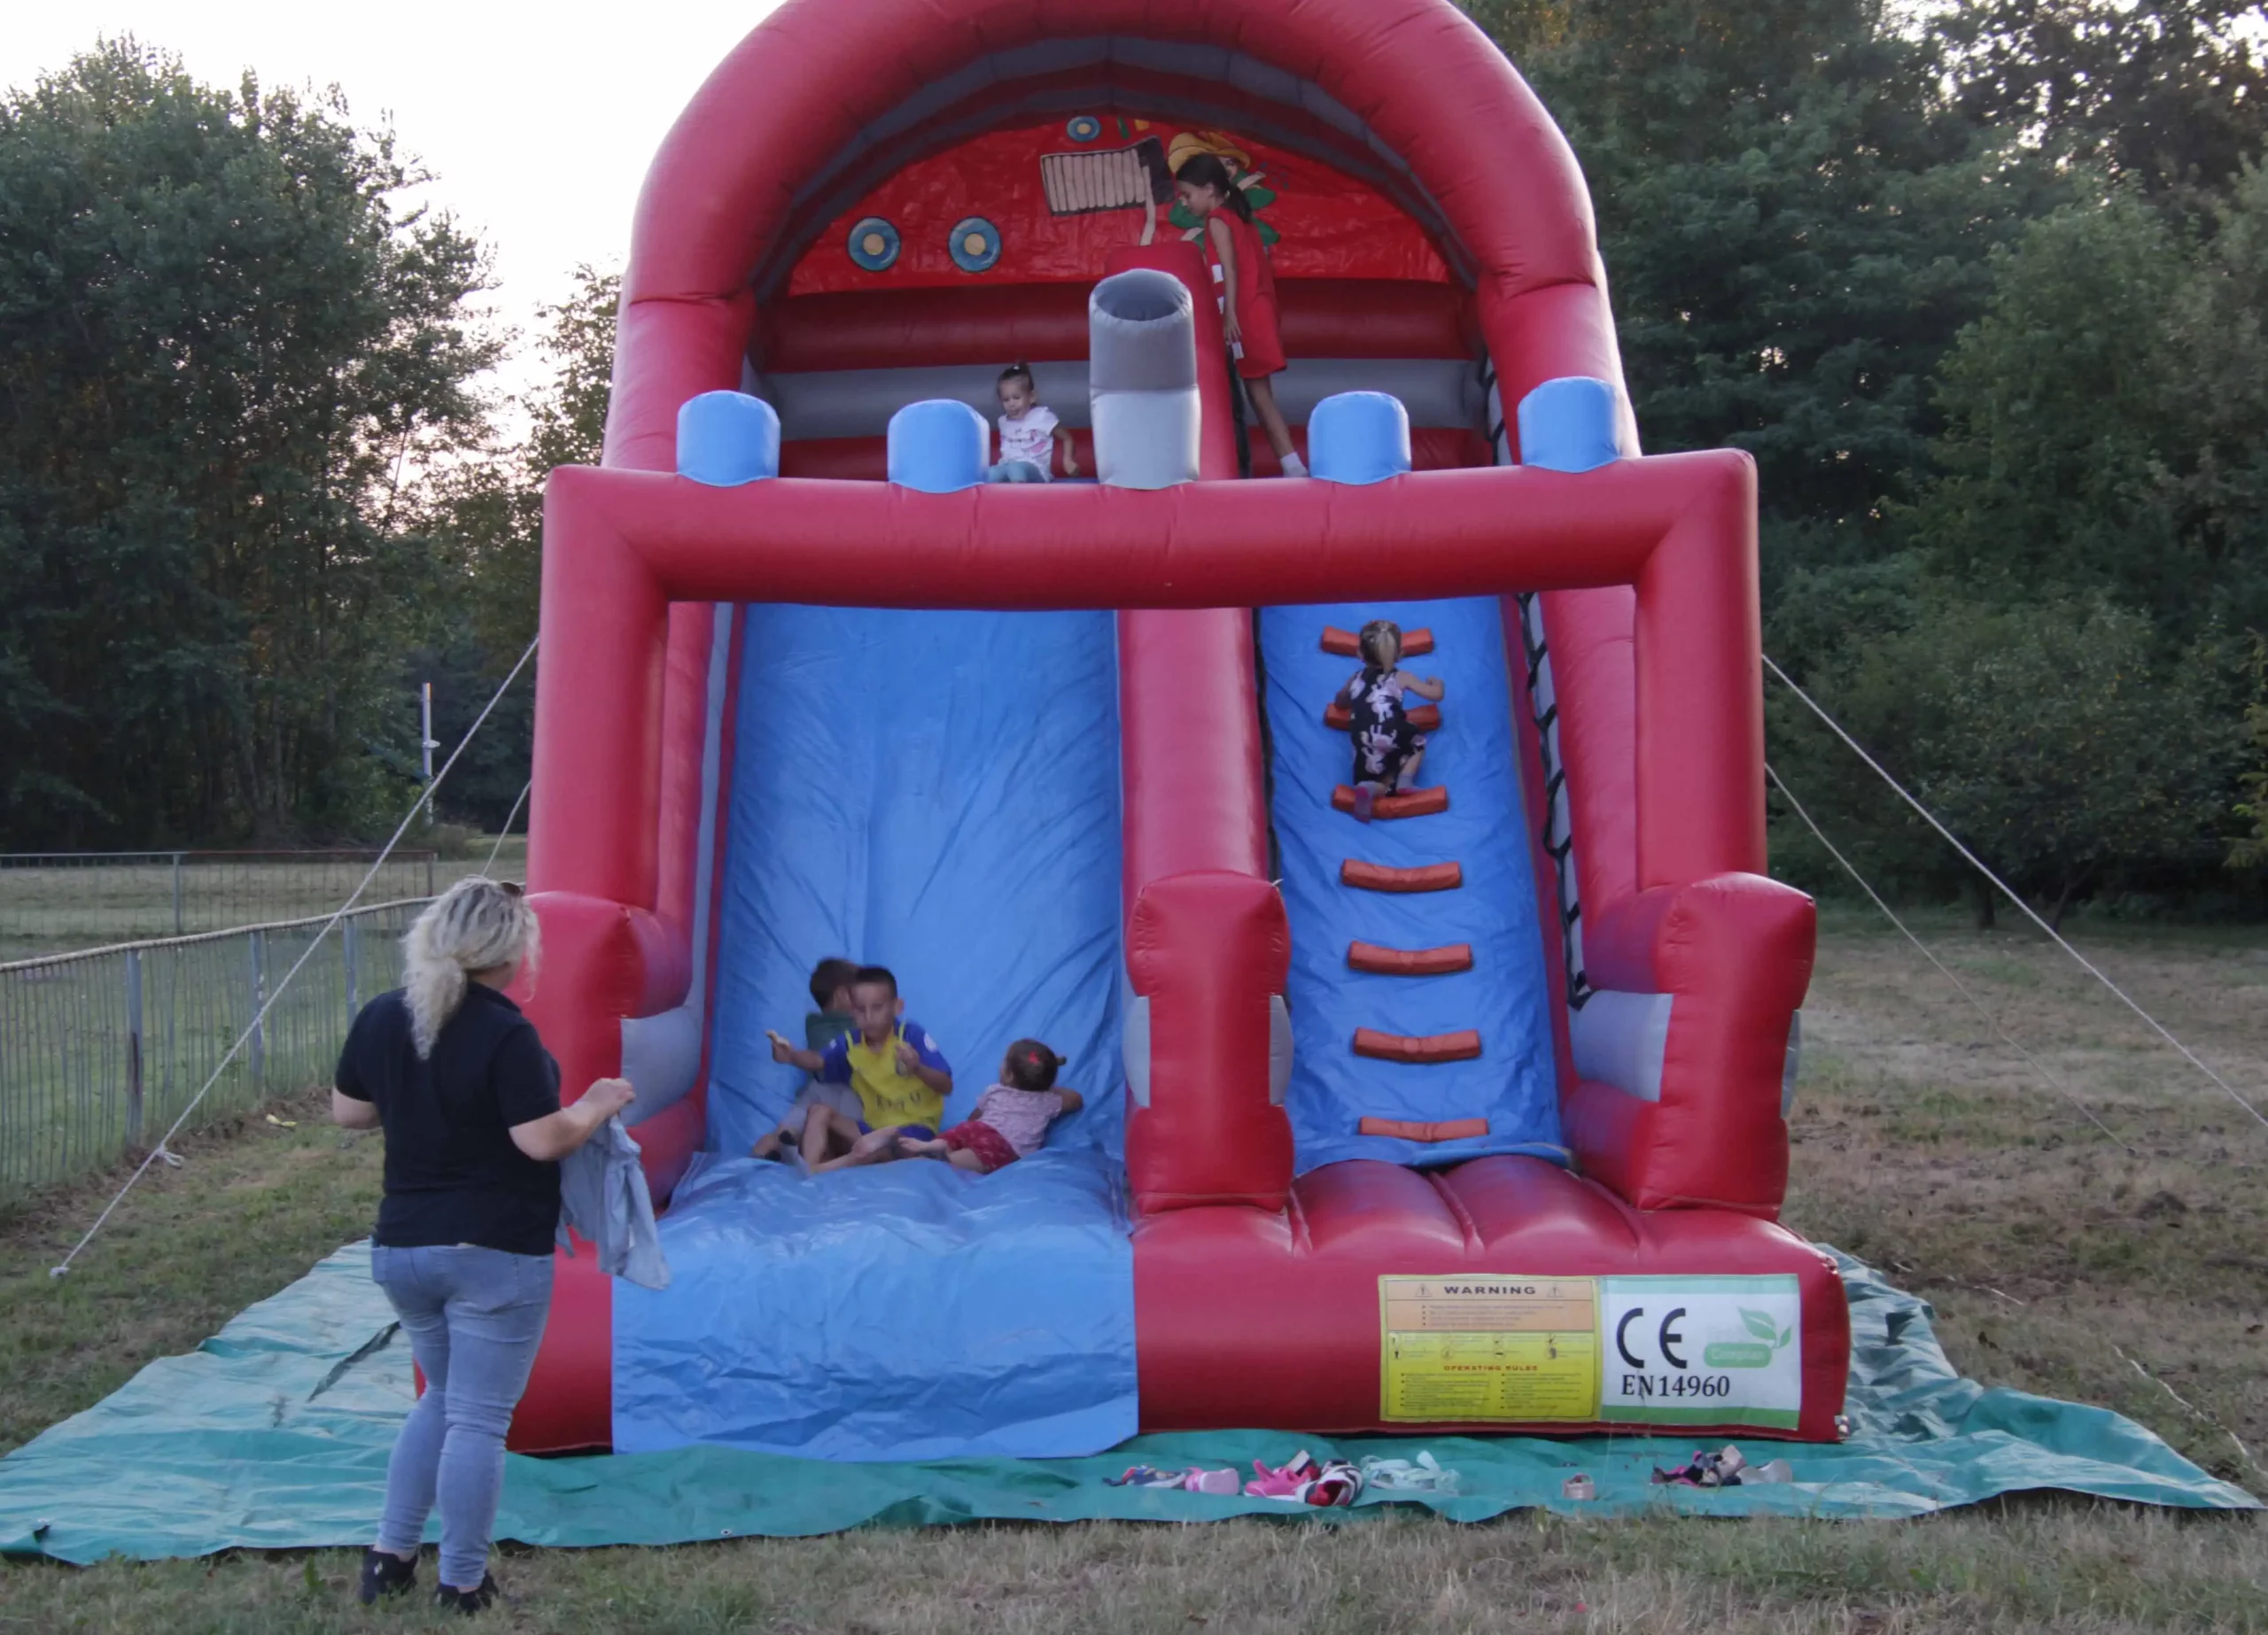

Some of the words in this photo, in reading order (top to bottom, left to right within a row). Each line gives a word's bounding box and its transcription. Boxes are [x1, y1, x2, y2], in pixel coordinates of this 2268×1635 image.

[1444, 1285, 1537, 1295] WARNING
[1616, 1307, 1688, 1369] CE
[1621, 1374, 1730, 1398] EN14960
